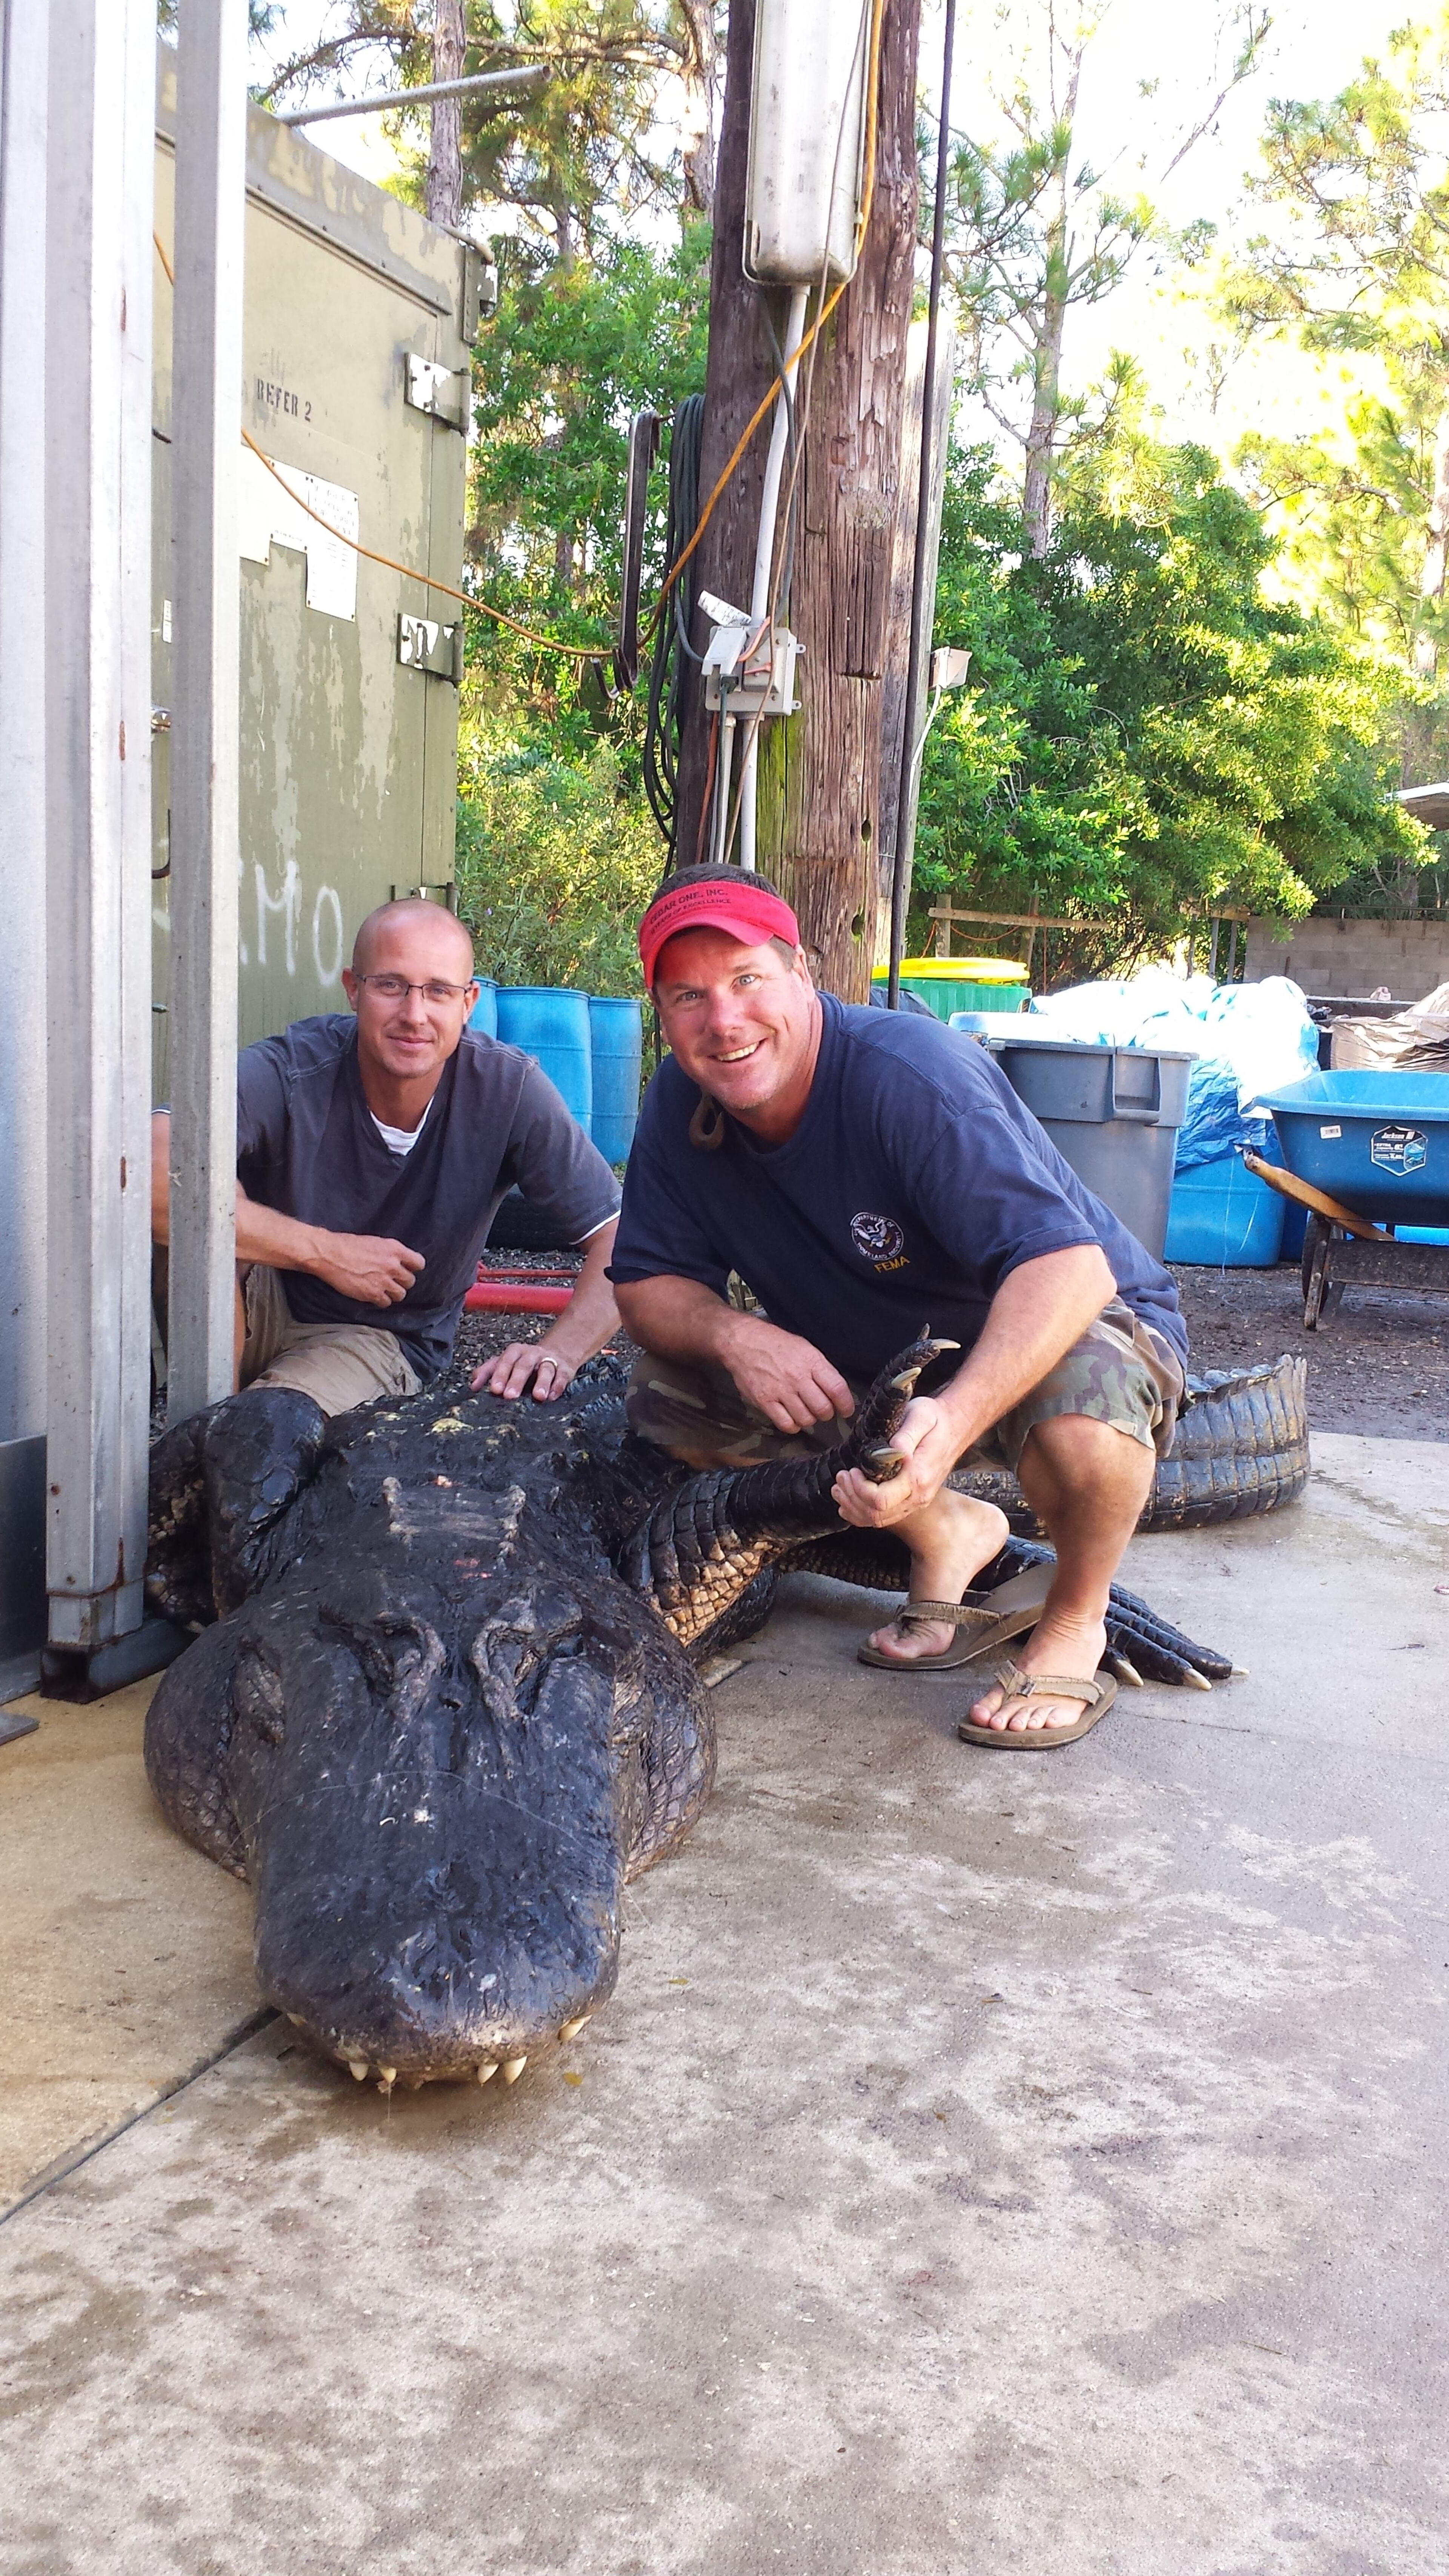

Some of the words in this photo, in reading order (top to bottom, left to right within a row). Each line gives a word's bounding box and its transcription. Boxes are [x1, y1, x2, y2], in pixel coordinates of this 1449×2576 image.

[257, 378, 298, 417] REFER
[305, 401, 311, 423] 2
[857, 1241, 888, 1259] HOMELAND
[888, 1231, 902, 1256] SECURITY
[874, 1255, 911, 1273] FEMA
